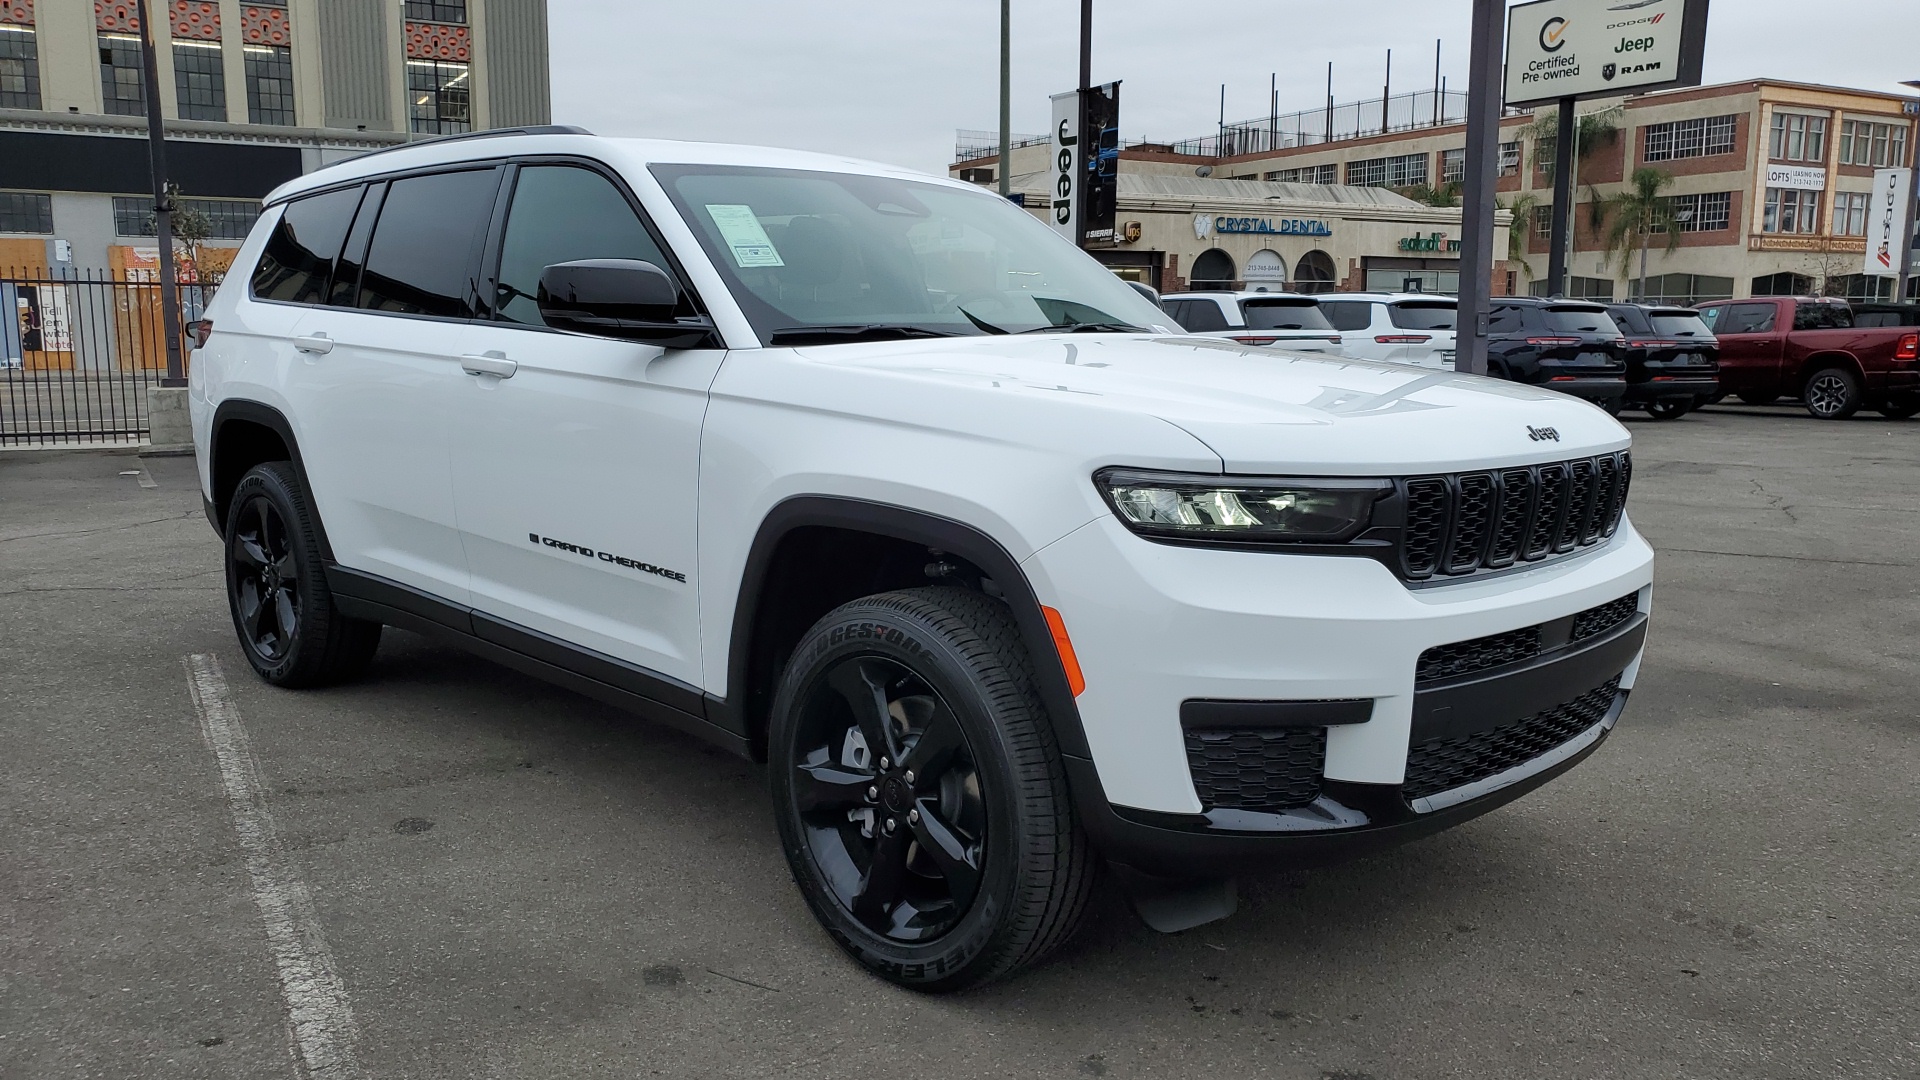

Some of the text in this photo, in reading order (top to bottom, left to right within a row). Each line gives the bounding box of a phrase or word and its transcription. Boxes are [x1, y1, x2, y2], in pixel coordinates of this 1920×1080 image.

[1606, 16, 1654, 30] DODGE
[1614, 36, 1655, 54] Jeep
[1528, 53, 1575, 72] Certified
[1620, 61, 1661, 75] RAM
[1521, 64, 1580, 84] Pre-owned
[1053, 118, 1078, 226] Jeep
[1767, 171, 1790, 182] LOFTS
[1792, 170, 1812, 178] LEASING
[1881, 174, 1897, 255] DODGE
[1215, 216, 1332, 234] CRYSTAL DENTAL
[1090, 228, 1114, 238] SIERRA
[1127, 227, 1141, 240] ups
[43, 306, 63, 316] Tell
[45, 328, 69, 338] with
[1526, 425, 1561, 442] Jeep
[542, 536, 687, 584] GRAND CHEROKEE
